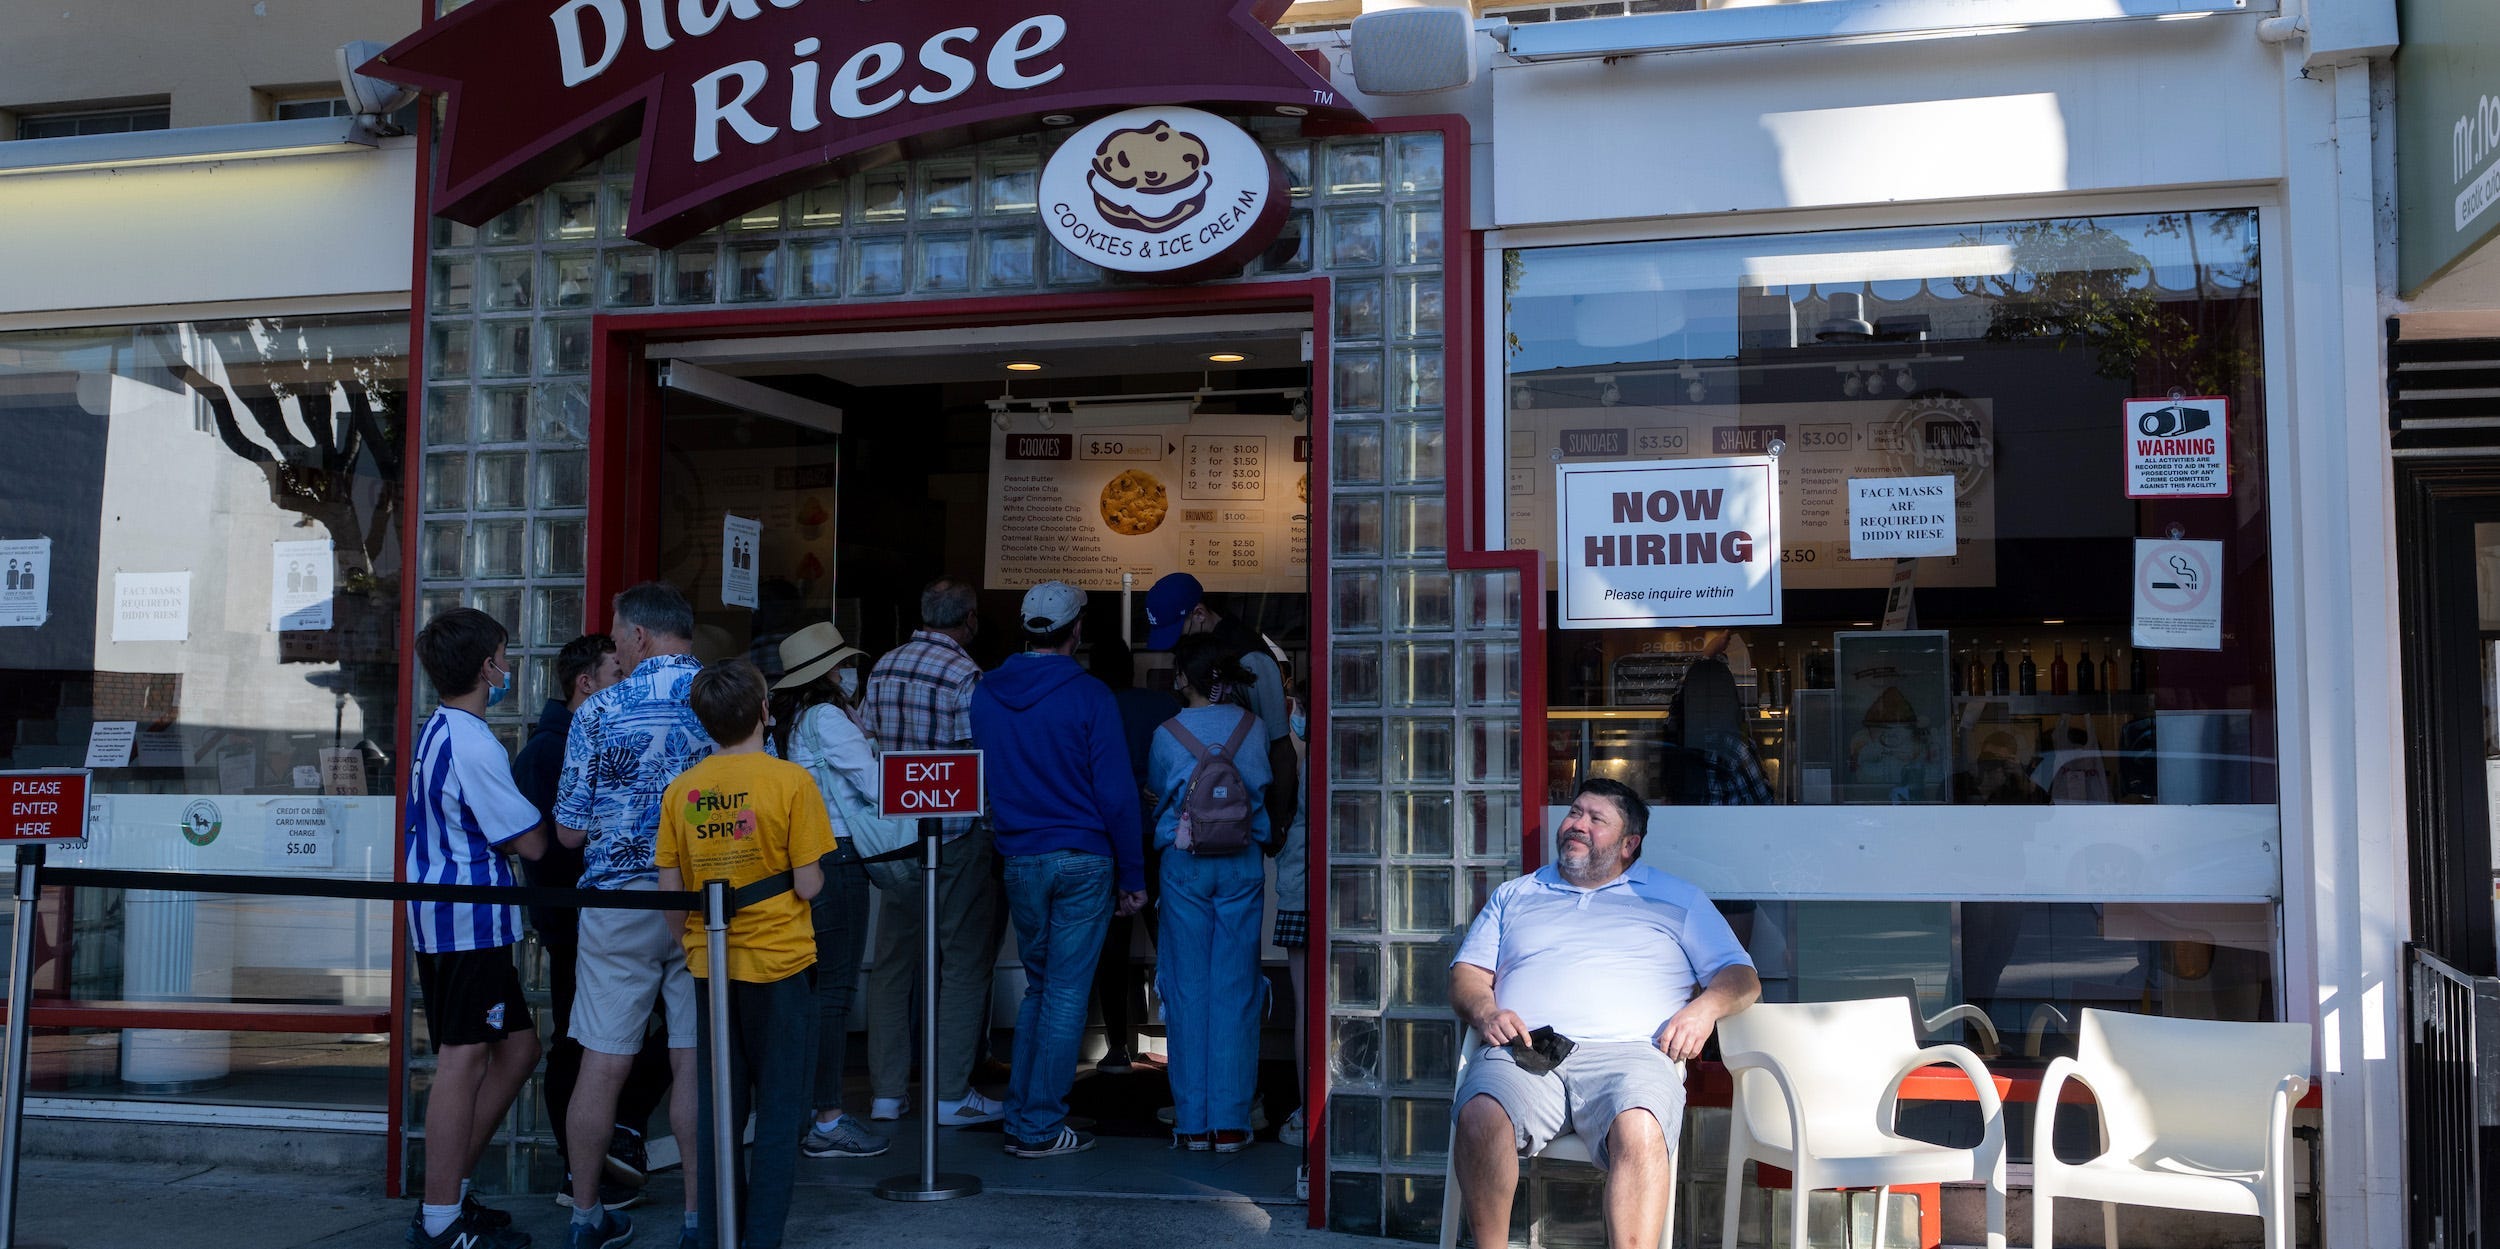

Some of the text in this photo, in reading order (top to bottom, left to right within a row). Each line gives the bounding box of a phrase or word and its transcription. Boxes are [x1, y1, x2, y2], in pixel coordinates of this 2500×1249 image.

[691, 14, 1069, 163] Riese
[1313, 90, 1334, 104] TM
[1053, 189, 1258, 258] COOKIES & ICE CREAM
[1639, 435, 1683, 449] $3.50
[1720, 430, 1757, 450] SHAVE
[1802, 431, 1848, 446] $3.00
[1933, 425, 1973, 446] DRINKS
[1018, 438, 1060, 457] COOKIES
[1090, 441, 1124, 455] $.50
[1190, 445, 1259, 454] 2 for $1.00
[1569, 433, 1618, 453] SUNDAES
[2137, 438, 2215, 456] WARNING
[1190, 457, 1258, 466] 3 for $1.50
[1189, 469, 1260, 478] 6 for $3.00
[1801, 467, 1843, 475] Strawberry
[1042, 485, 1059, 493] Chip
[1188, 481, 1260, 490] 12 for $6.00
[1861, 486, 1943, 498] FACE MASKS
[1003, 495, 1025, 503] Sugar
[1612, 488, 1724, 523] NOW
[1064, 505, 1081, 513] Chip
[1889, 501, 1915, 511] ARE
[1002, 515, 1025, 523] Candy
[1066, 515, 1082, 523] Chip
[1185, 511, 1214, 521] BROWNIES
[1860, 515, 1928, 528] REQUIRED
[1932, 514, 1945, 524] IN
[1862, 529, 1945, 541] DIDDY RIESE
[1208, 549, 1220, 557] for
[1584, 530, 1753, 567] HIRING
[1101, 555, 1118, 563] Chip
[1187, 559, 1259, 567] 12 for $10.00
[123, 586, 182, 596] FACE MASKS
[1604, 586, 1734, 602] Please inquire within
[121, 599, 181, 609] REQUIRED IN
[121, 610, 180, 621] DIDDY RIESE
[905, 762, 955, 781] EXIT
[13, 781, 62, 795] PLEASE
[696, 791, 749, 812] FRUIT
[900, 789, 960, 808] ONLY
[12, 802, 58, 815] ENTER
[15, 822, 52, 835] HERE
[295, 818, 326, 826] MINIMUM
[289, 829, 316, 837] CHARGE
[286, 841, 317, 856] $5.00
